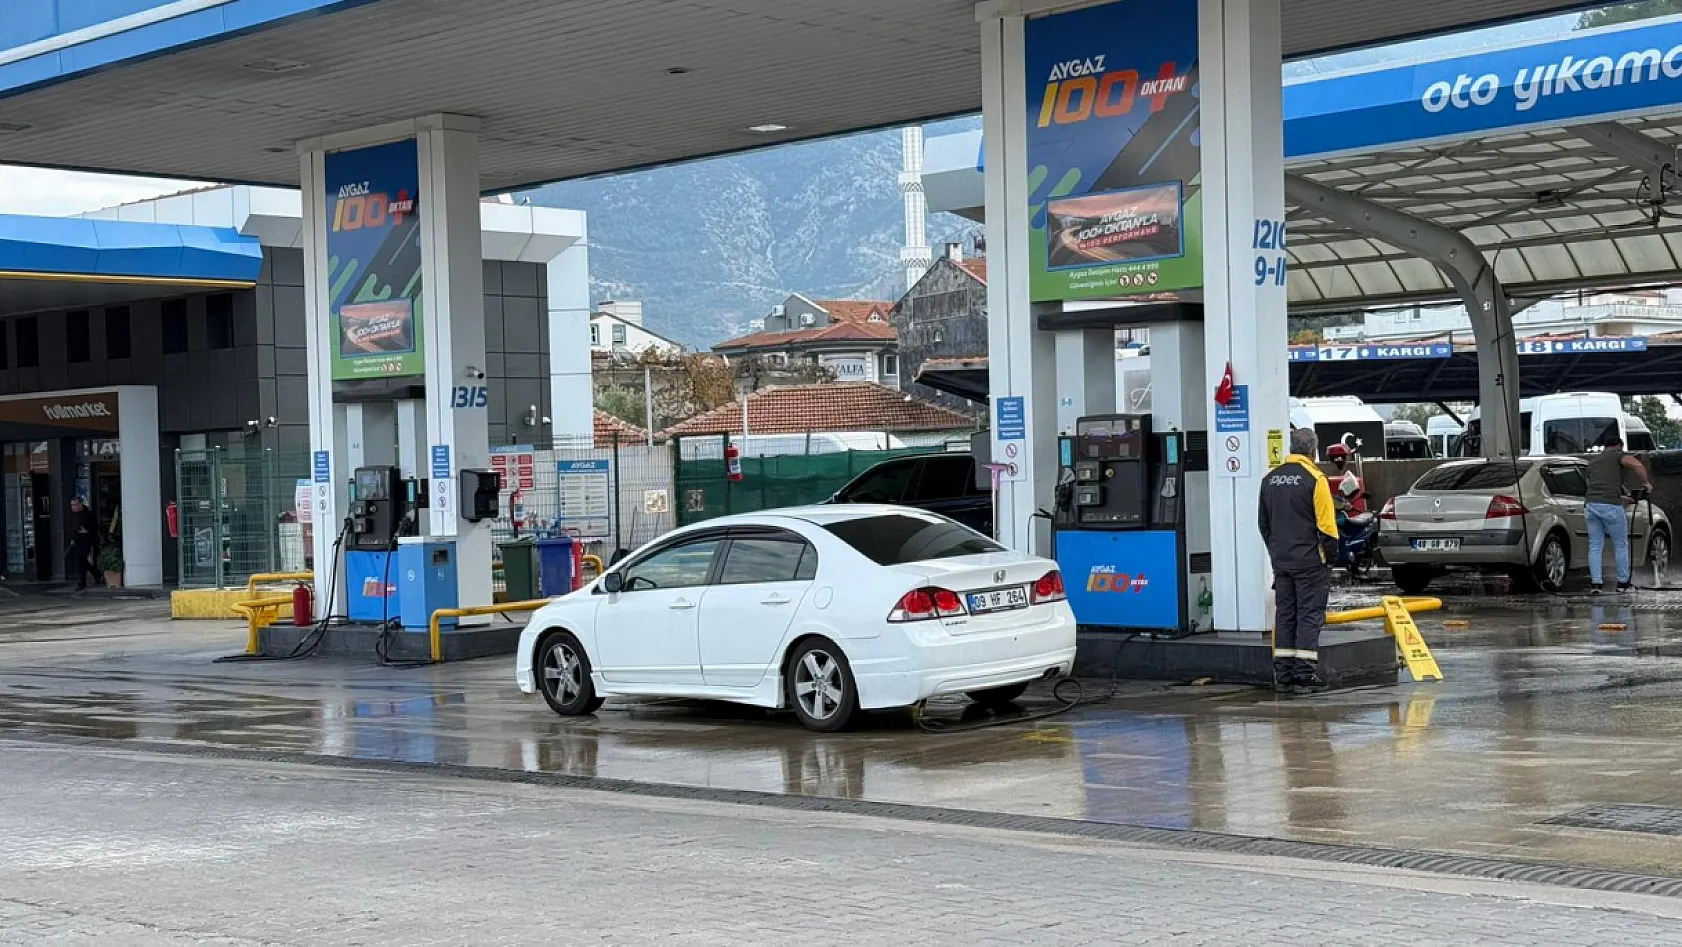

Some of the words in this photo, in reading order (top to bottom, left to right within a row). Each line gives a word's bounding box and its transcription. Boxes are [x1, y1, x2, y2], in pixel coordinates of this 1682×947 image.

[1048, 54, 1106, 81] AYGAZ
[1140, 76, 1186, 96] OKTAN
[1421, 73, 1499, 113] oto
[338, 181, 370, 198] AYGAZ
[1100, 206, 1139, 224] AYGAZ
[1320, 348, 1354, 360] 17
[1377, 346, 1430, 357] KARGI
[1516, 340, 1547, 353] 18
[1572, 339, 1625, 350] KARGI
[975, 595, 987, 608] 09
[1006, 590, 1024, 604] 264
